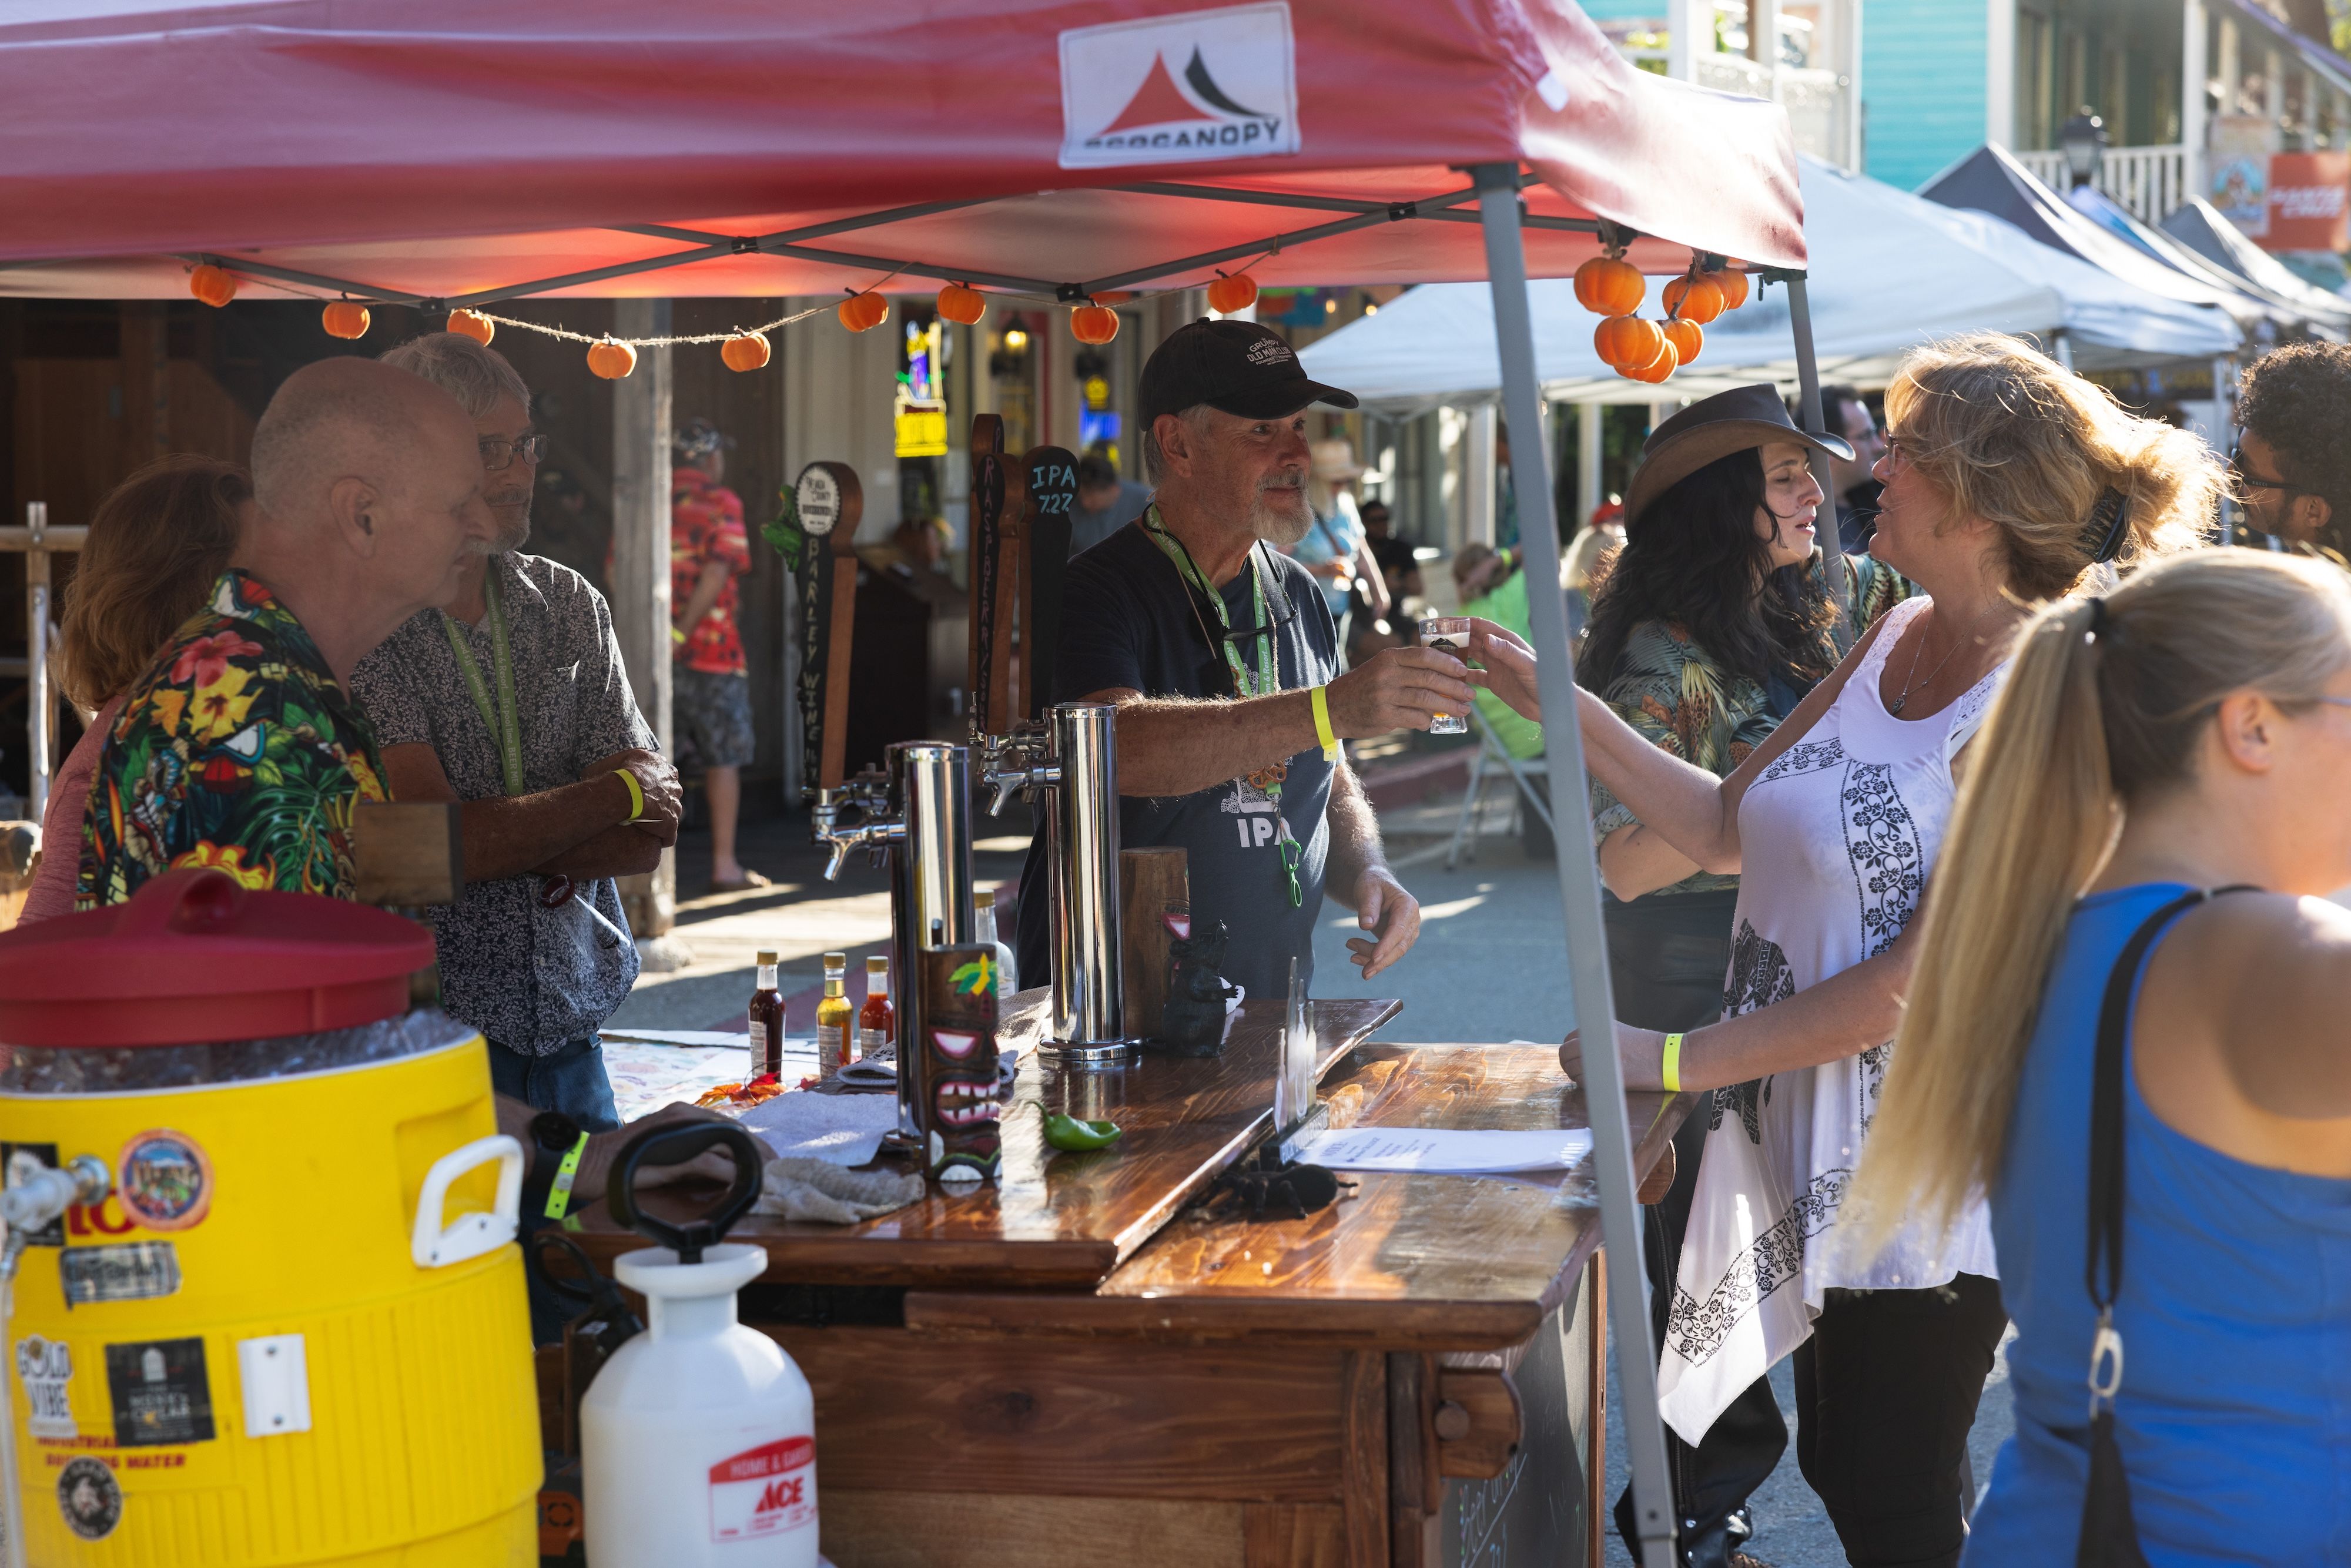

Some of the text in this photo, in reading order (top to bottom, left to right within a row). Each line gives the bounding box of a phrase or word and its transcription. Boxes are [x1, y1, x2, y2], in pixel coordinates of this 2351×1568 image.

[1247, 351, 1264, 362] OLD
[1262, 347, 1278, 357] MAN
[1249, 339, 1280, 352] GRUMPY
[1255, 356, 1275, 366] FOUNDER
[1032, 464, 1076, 490] IPA
[980, 457, 995, 670] RASPBERRY
[804, 537, 820, 664] BARLEY
[496, 644, 504, 656] Inn
[803, 672, 820, 742] WINE
[503, 711, 513, 726] pool
[508, 747, 517, 769] BEER
[510, 771, 519, 786] ME!
[1237, 817, 1296, 847] IPA
[126, 1453, 186, 1469] WATER
[729, 1456, 769, 1478] HOME
[771, 1455, 783, 1472] &
[755, 1476, 805, 1515] ACE
